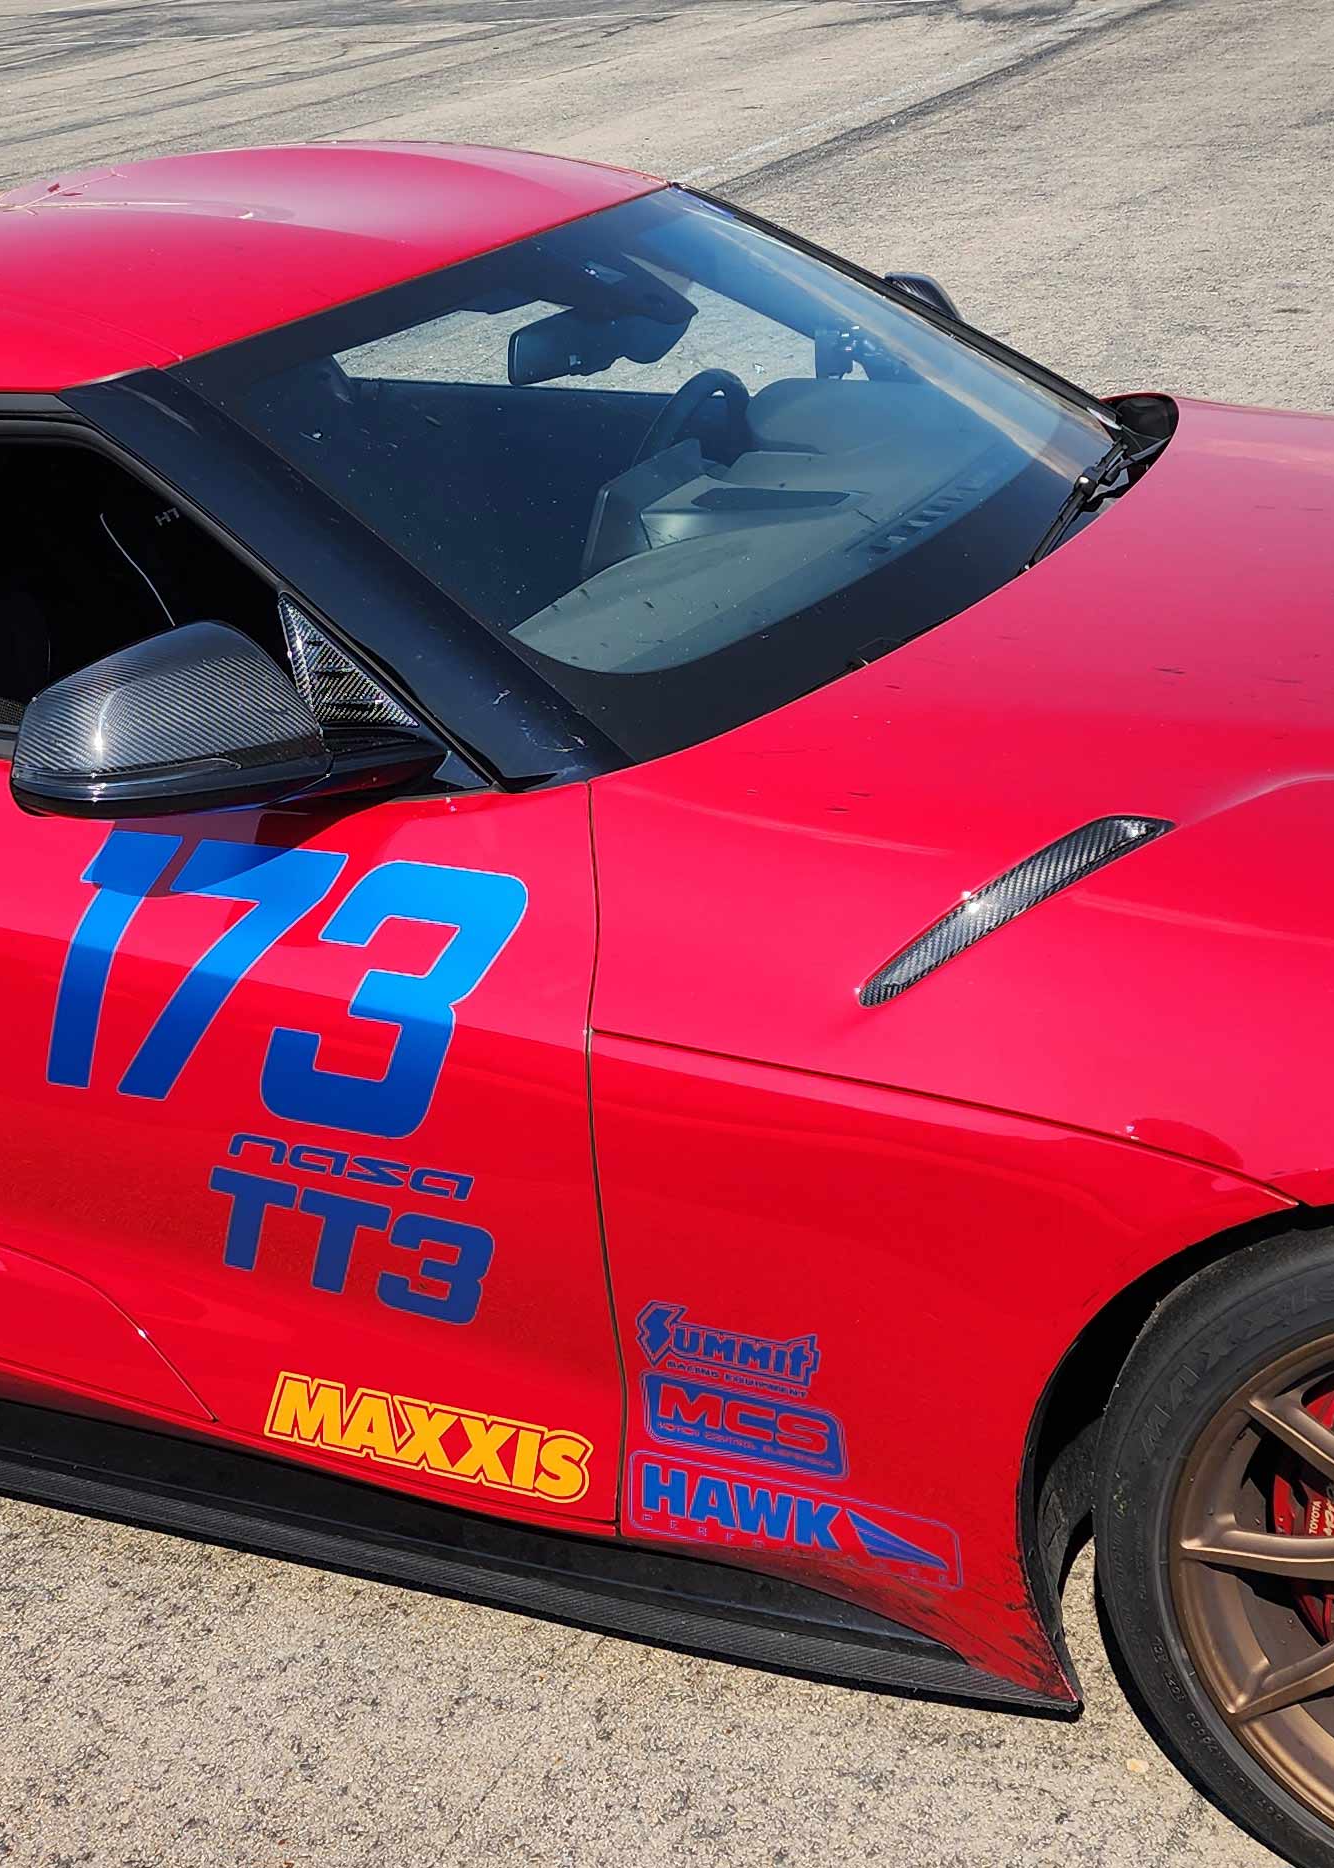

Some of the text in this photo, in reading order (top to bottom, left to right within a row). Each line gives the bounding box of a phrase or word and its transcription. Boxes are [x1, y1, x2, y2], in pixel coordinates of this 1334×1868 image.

[46, 830, 529, 1139] 173
[228, 1132, 475, 1201] nasa
[209, 1165, 495, 1326] TT3
[266, 1373, 593, 1502] MAXXIS
[657, 1384, 830, 1455] MCS
[643, 1463, 844, 1551] HAWK
